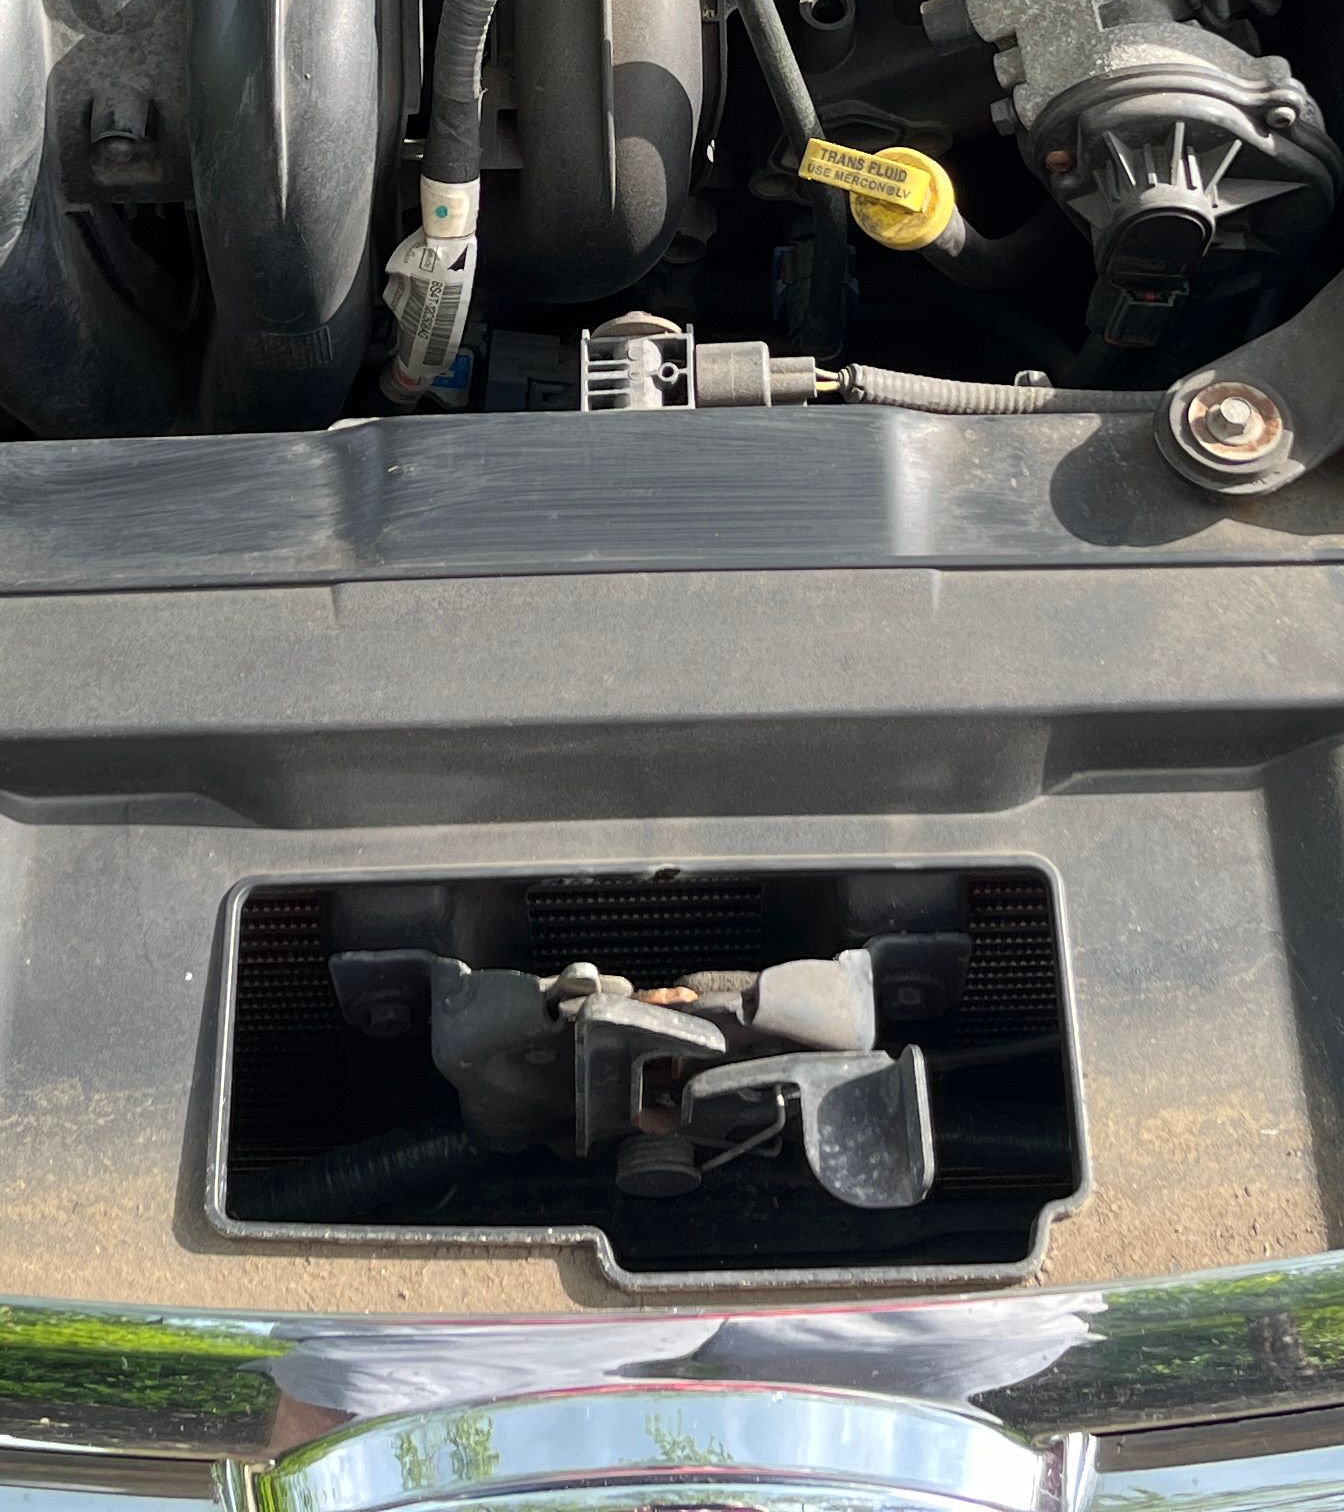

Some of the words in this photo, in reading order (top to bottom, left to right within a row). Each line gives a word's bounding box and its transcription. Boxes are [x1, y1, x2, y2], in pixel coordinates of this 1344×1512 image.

[807, 163, 832, 178] USE
[820, 147, 865, 171] TRANS
[867, 161, 908, 183] FLUID
